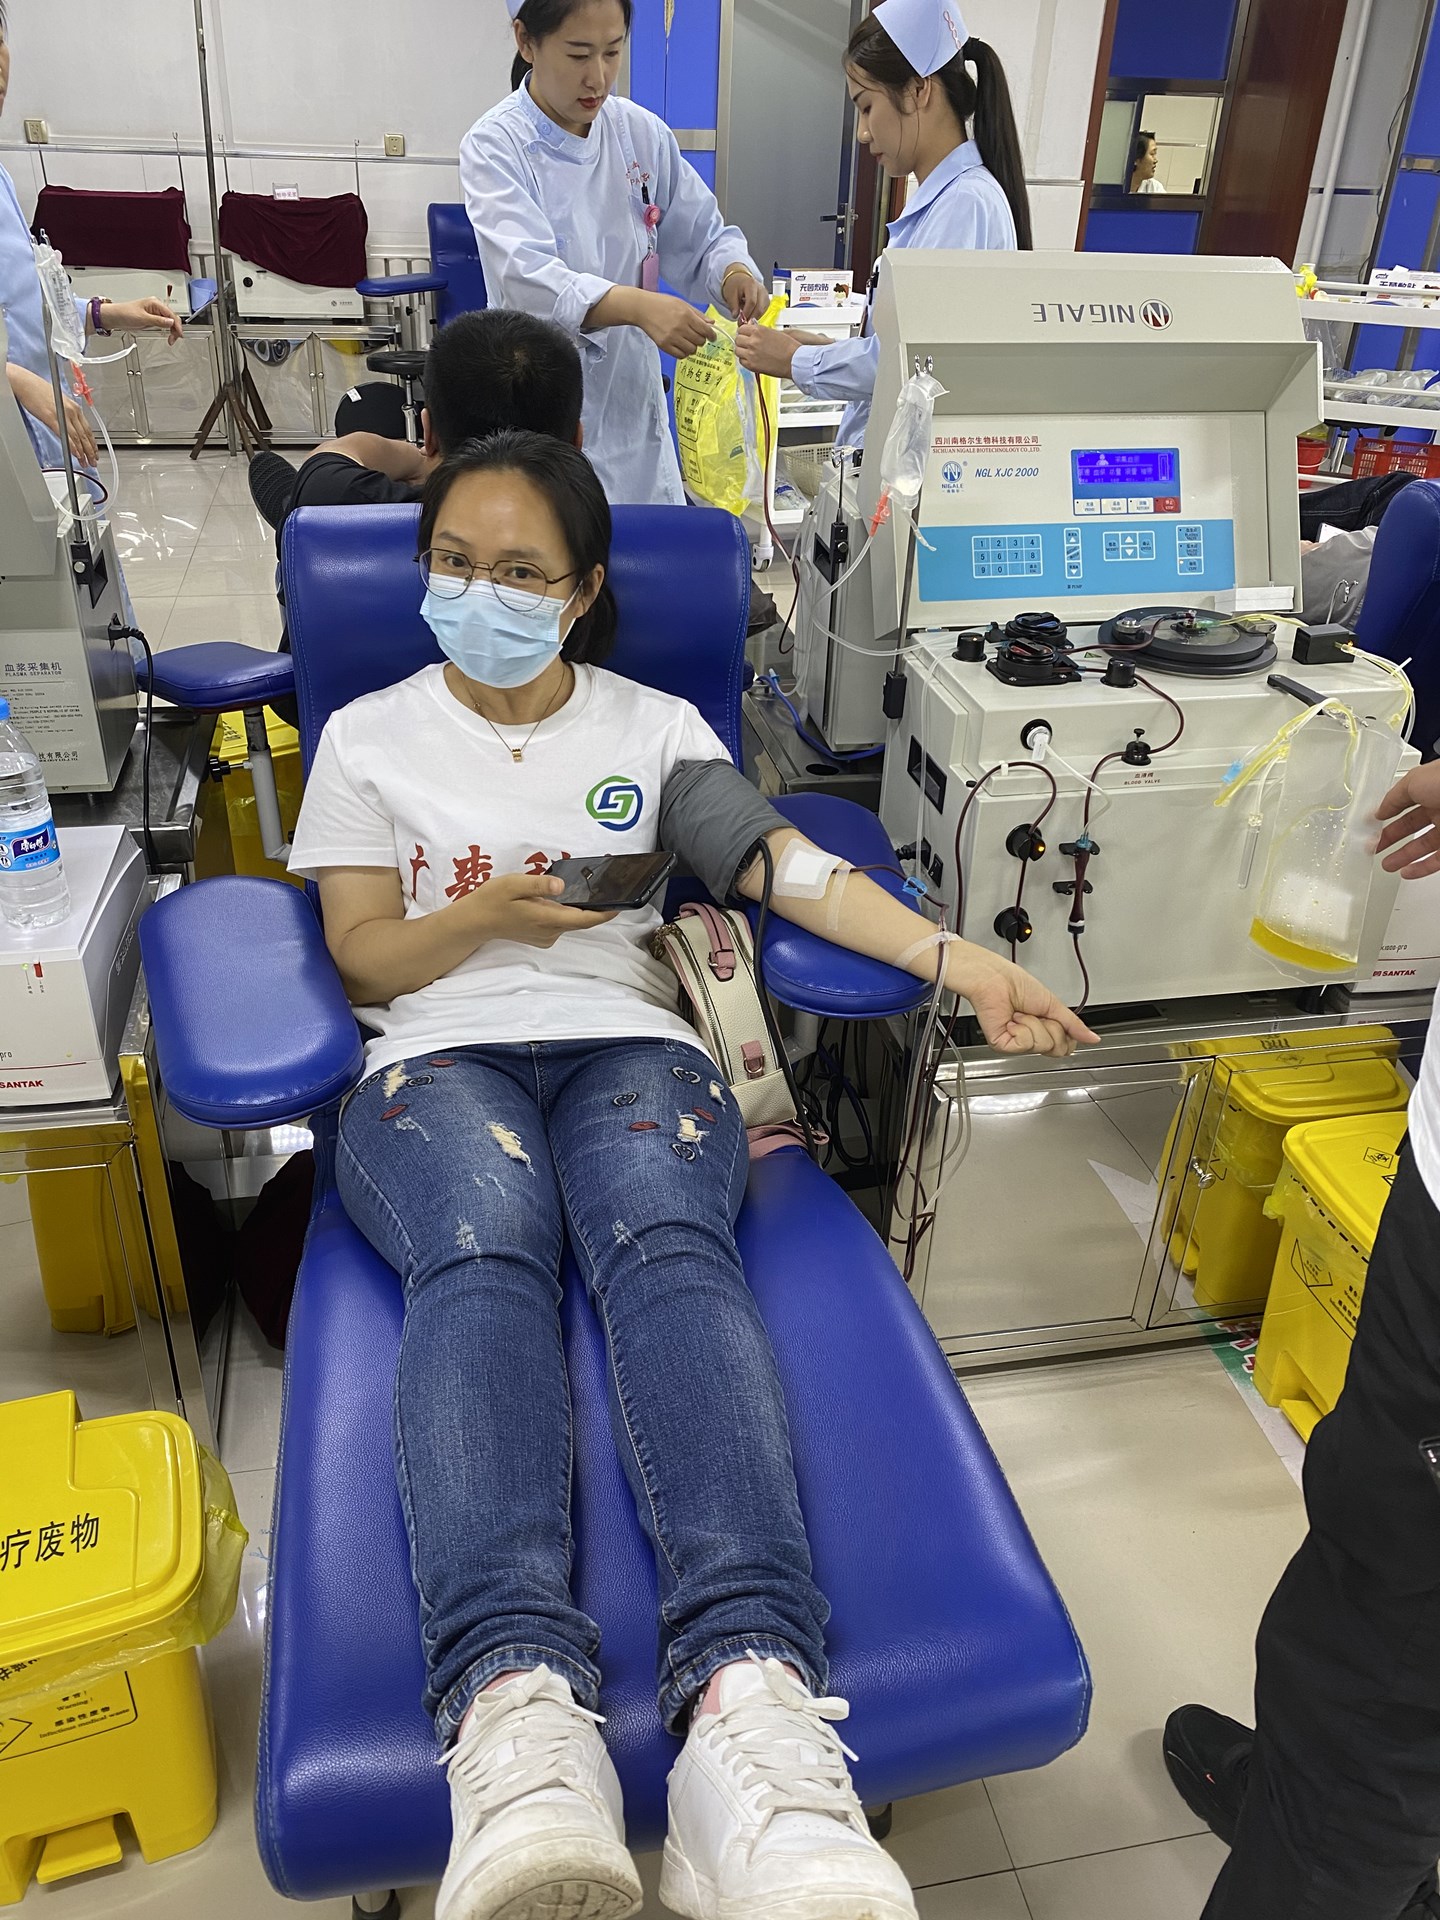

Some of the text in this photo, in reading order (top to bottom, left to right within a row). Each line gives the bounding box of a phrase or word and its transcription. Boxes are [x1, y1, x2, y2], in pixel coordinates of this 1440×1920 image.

[1030, 303, 1135, 323] NIGALE
[934, 436, 1039, 445] 四川南格尔生物科技有限公司
[975, 467, 1039, 478] NGL XJC 2000
[4, 662, 62, 672] 血浆采集机
[0, 1080, 44, 1089] SANTAK
[0, 1512, 100, 1572] 疗废物
[78, 1715, 107, 1727] medical
[109, 1708, 130, 1718] waste
